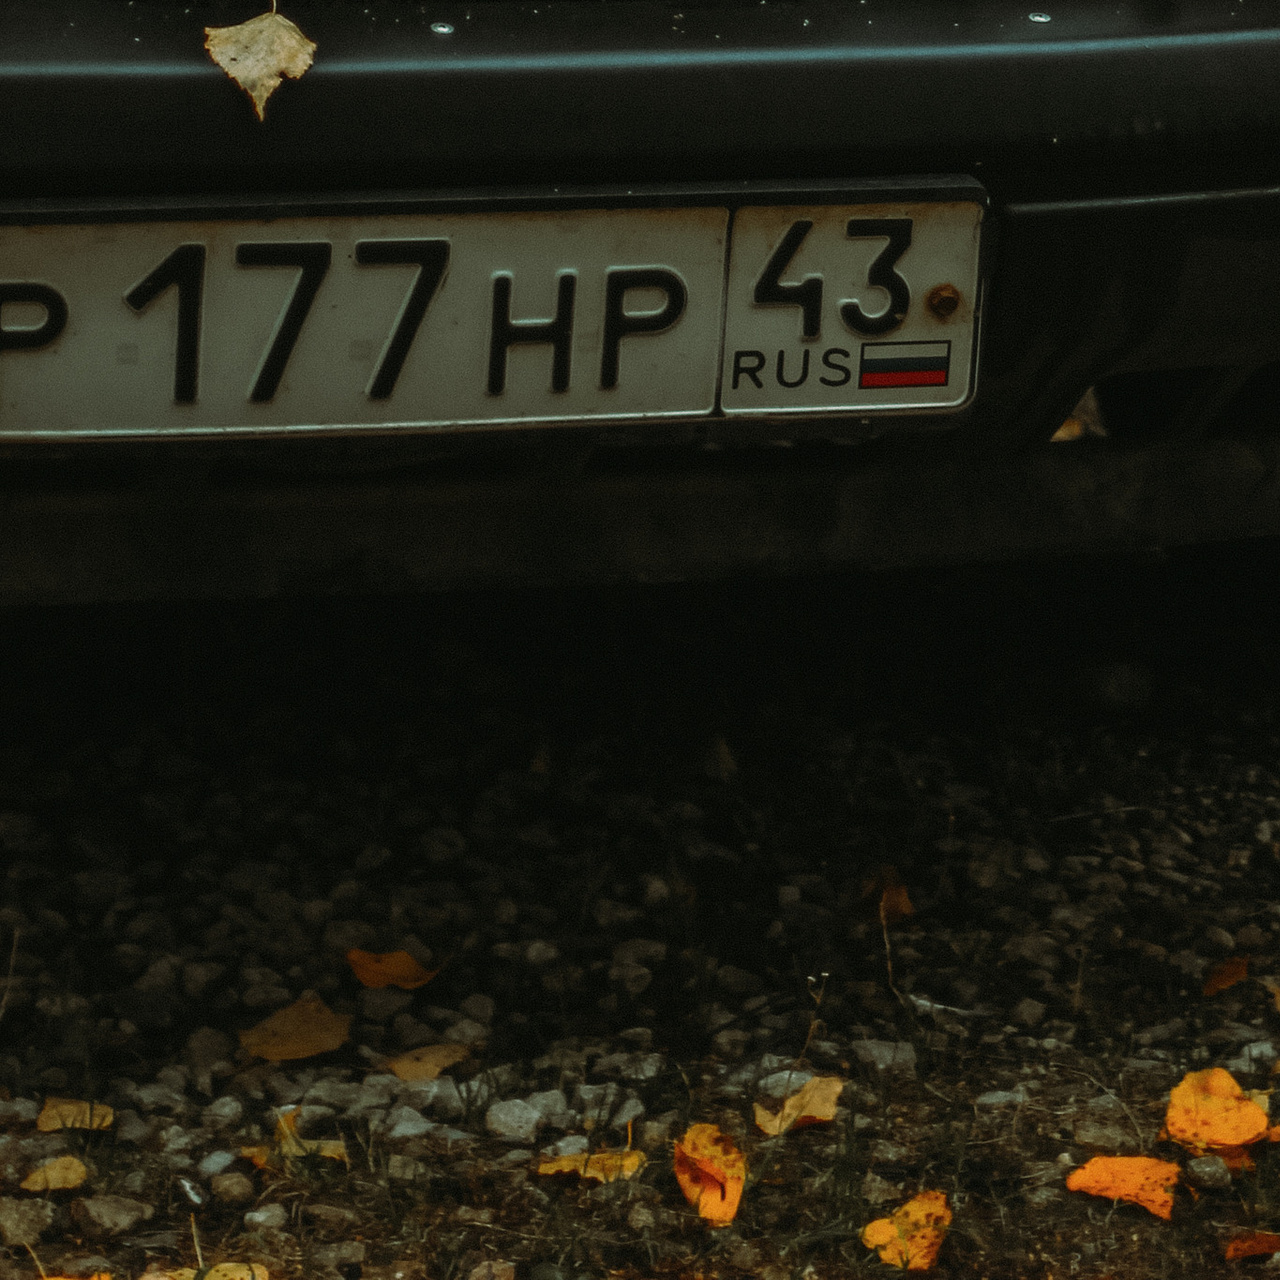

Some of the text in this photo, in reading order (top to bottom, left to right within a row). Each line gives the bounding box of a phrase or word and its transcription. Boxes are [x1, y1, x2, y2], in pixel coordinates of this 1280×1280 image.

[125, 238, 451, 403] 177
[487, 266, 687, 395] HP
[753, 218, 914, 340] 43
[732, 347, 852, 391] RUS
